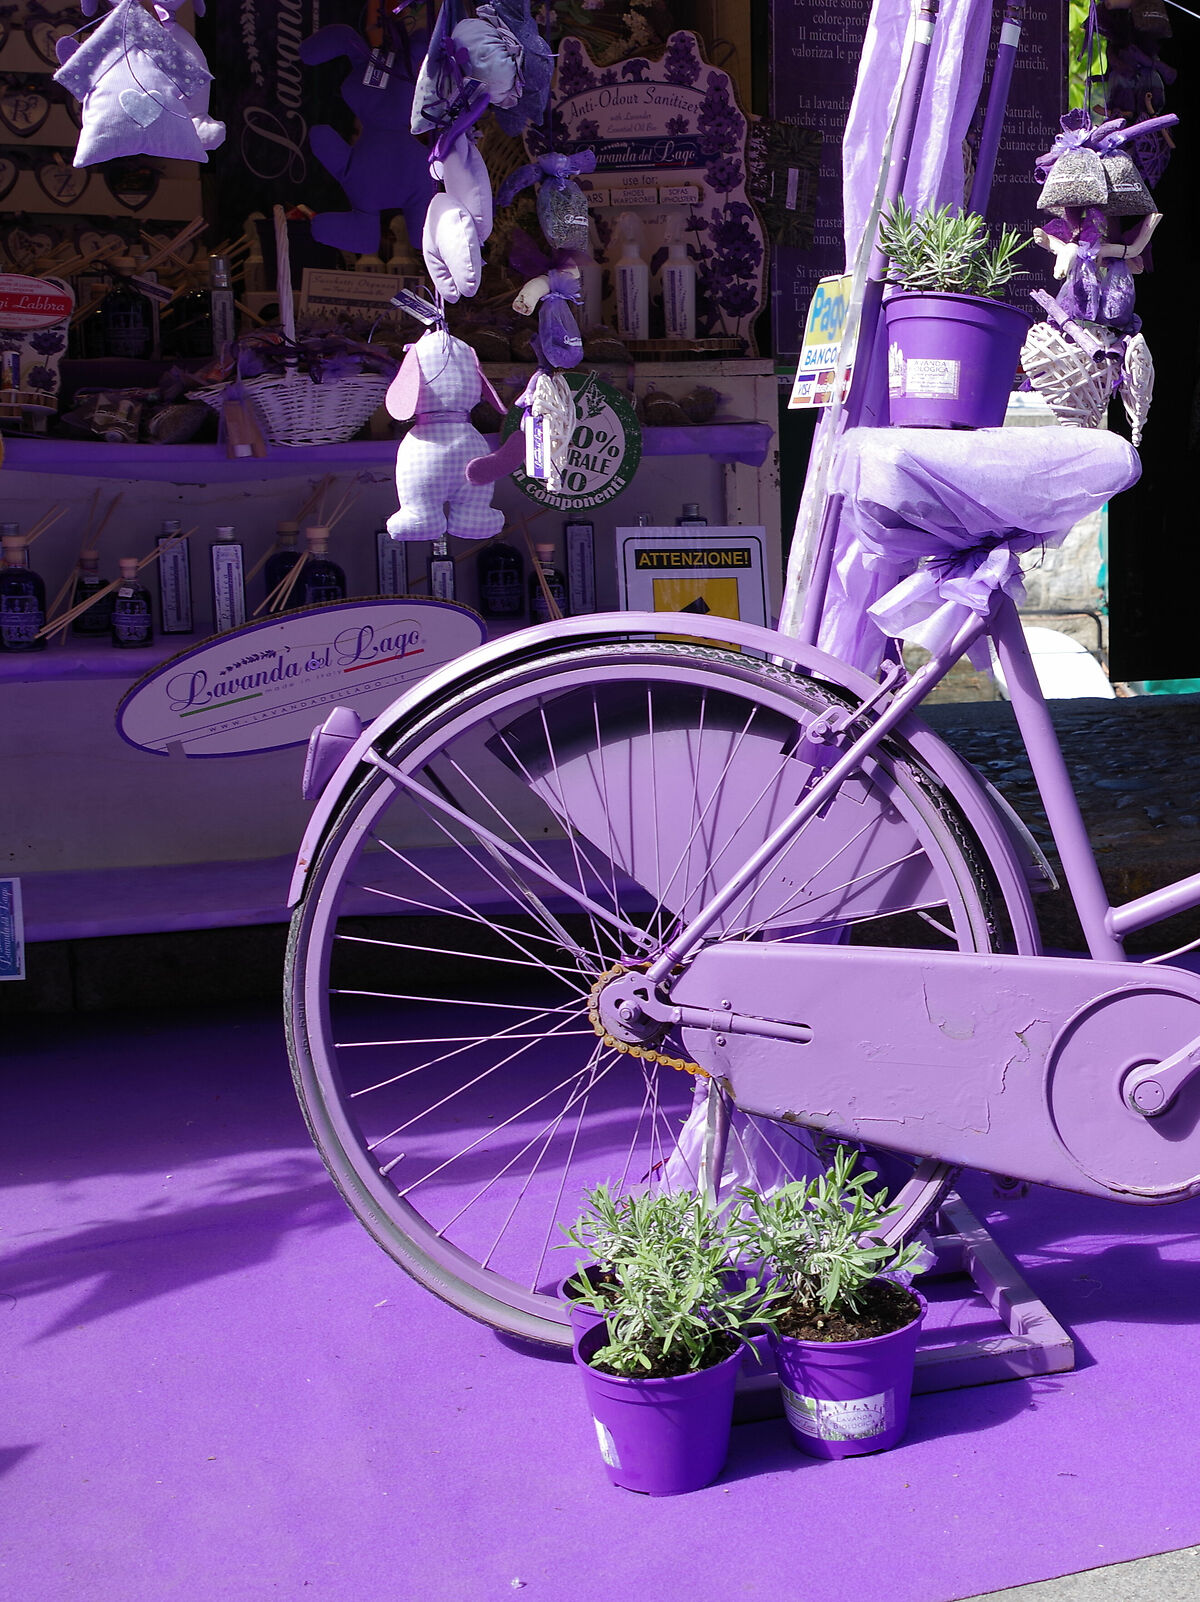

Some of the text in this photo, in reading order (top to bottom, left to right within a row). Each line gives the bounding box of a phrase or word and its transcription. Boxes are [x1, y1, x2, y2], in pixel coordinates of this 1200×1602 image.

[809, 28, 864, 43] microclima
[791, 43, 833, 59] valorizza
[836, 44, 845, 60] le
[643, 86, 700, 114] Sanitizer
[799, 95, 811, 109] La
[813, 95, 850, 110] lavanda
[1027, 121, 1056, 135] dolore
[653, 140, 696, 166] Lago
[621, 175, 639, 186] use
[813, 234, 841, 247] onno,
[16, 295, 65, 311] Labbra
[804, 347, 838, 366] BANCO
[567, 448, 612, 476] RALE
[525, 475, 626, 511] componenti
[639, 551, 749, 567] ATTENZIONE!
[166, 655, 301, 712] Lavanda
[333, 625, 420, 666] Lago
